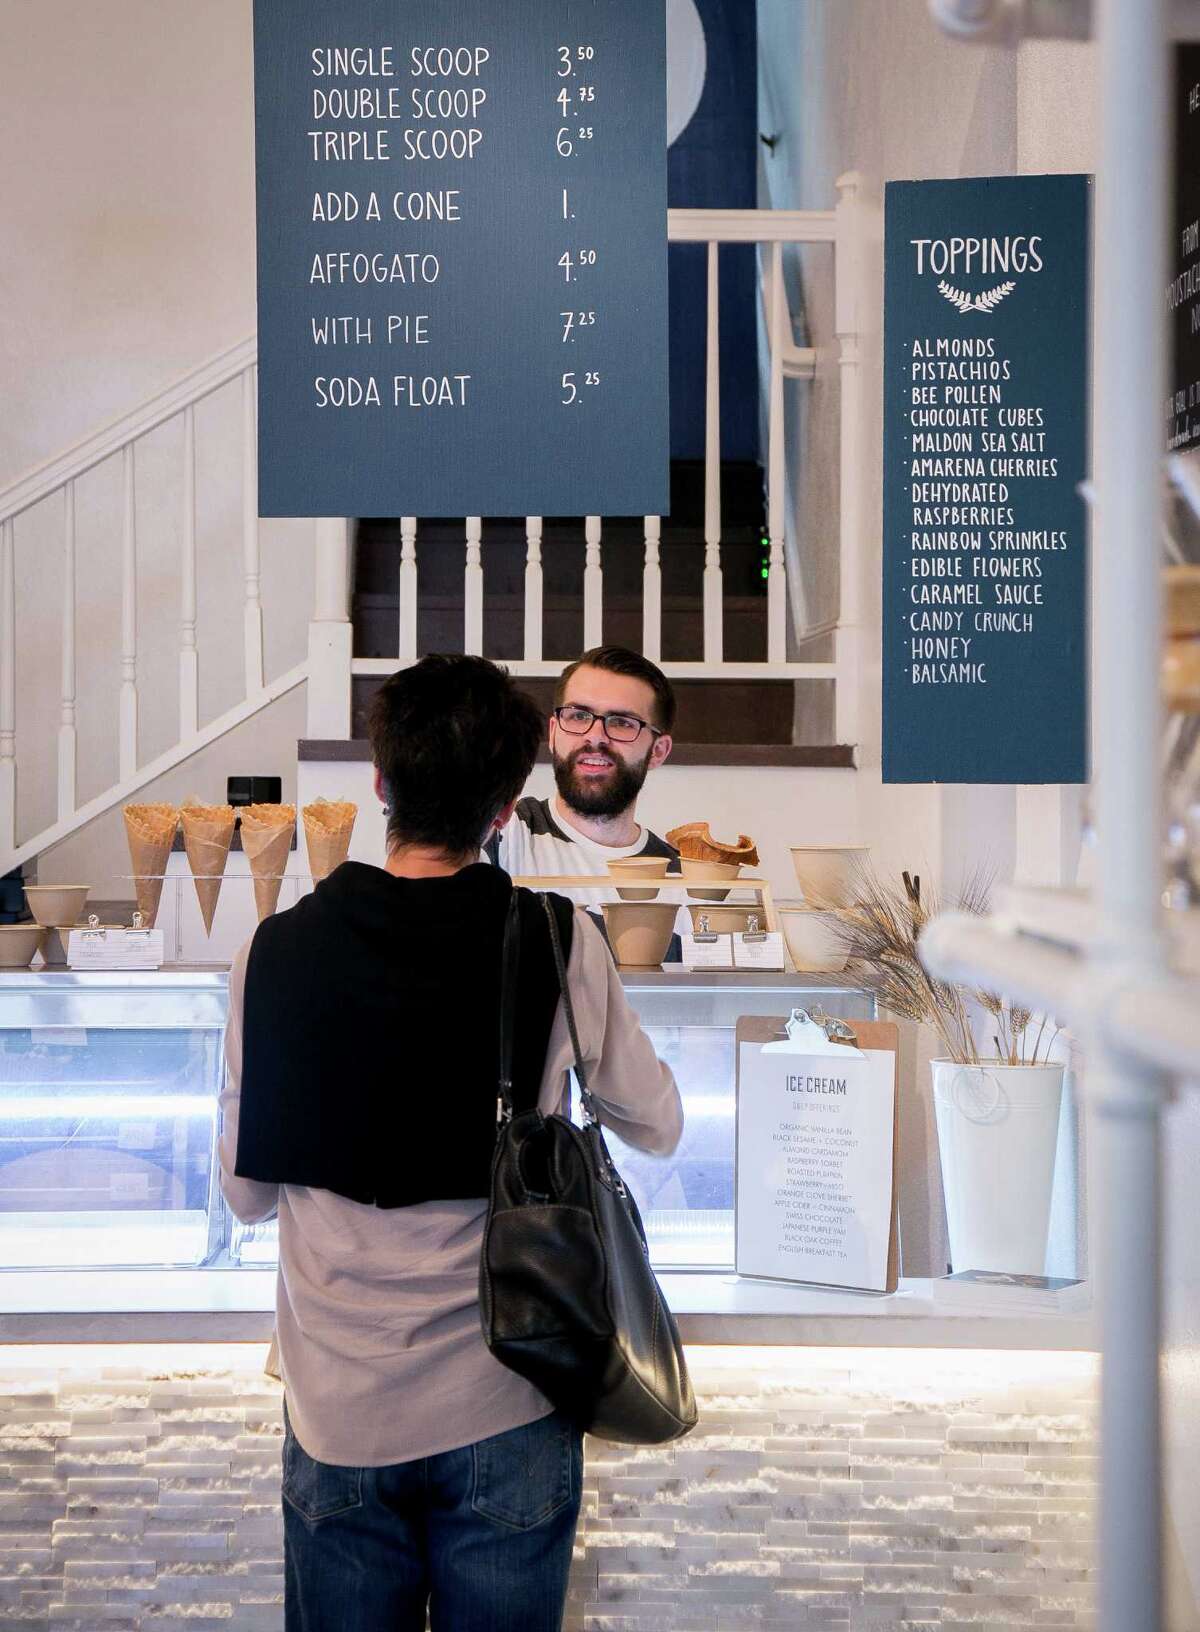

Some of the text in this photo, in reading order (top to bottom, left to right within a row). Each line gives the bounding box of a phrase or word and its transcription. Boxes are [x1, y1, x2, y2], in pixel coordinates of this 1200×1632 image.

[312, 47, 393, 76] SINGLE
[411, 47, 489, 76] SCOOP
[314, 88, 400, 119] DOUBLE
[412, 88, 486, 118] SCOOP
[308, 130, 389, 160] TRIPLE
[405, 129, 482, 159] SCOOP
[313, 192, 358, 221] ADD
[366, 192, 380, 221] A
[394, 191, 460, 220] CONE
[910, 236, 1042, 274] TOPPINGS
[310, 253, 439, 283] AFFOGATO
[312, 317, 371, 344] WITH
[389, 316, 429, 343] PIE
[913, 338, 994, 357] ALMONDS
[913, 360, 1010, 380] PISTACHIOS
[315, 377, 380, 407] SODA
[395, 376, 470, 406] FLOAT
[912, 385, 1000, 404] BEE POLLEN
[911, 408, 1043, 426] CHOCOLATE CUBES
[913, 432, 1045, 452] MALDON SEA SALT
[911, 458, 1057, 476] AMARENA CHERRIES
[913, 483, 1008, 502] DEHYDRATED
[914, 507, 1013, 525] RASPBERRIES
[912, 531, 1066, 550] RAINBOW SPRINKLES
[912, 557, 1042, 577] EDIBLE FLOWERS
[911, 584, 1043, 604] CARAMEL SAUCE
[910, 611, 1032, 632] CANDY CRUNCH
[912, 637, 971, 659] HONEY
[913, 663, 986, 684] BALSAMIC
[786, 1075, 847, 1095] ICE CREAM
[779, 1123, 852, 1135] ORGANIC VANILLA BEAN
[773, 1134, 791, 1142] BLACK
[793, 1136, 816, 1144] SESAME
[825, 1138, 859, 1148] COCONUT
[783, 1146, 848, 1157] ALMOND CARDAMOM
[787, 1157, 843, 1168] RASPBERRY SORBET
[777, 1189, 804, 1198] ORANGE
[774, 1200, 790, 1208] APPLE
[792, 1201, 810, 1210] CIDER
[782, 1222, 809, 1232] JAPANESE
[805, 1214, 842, 1224] CHOCOLATE
